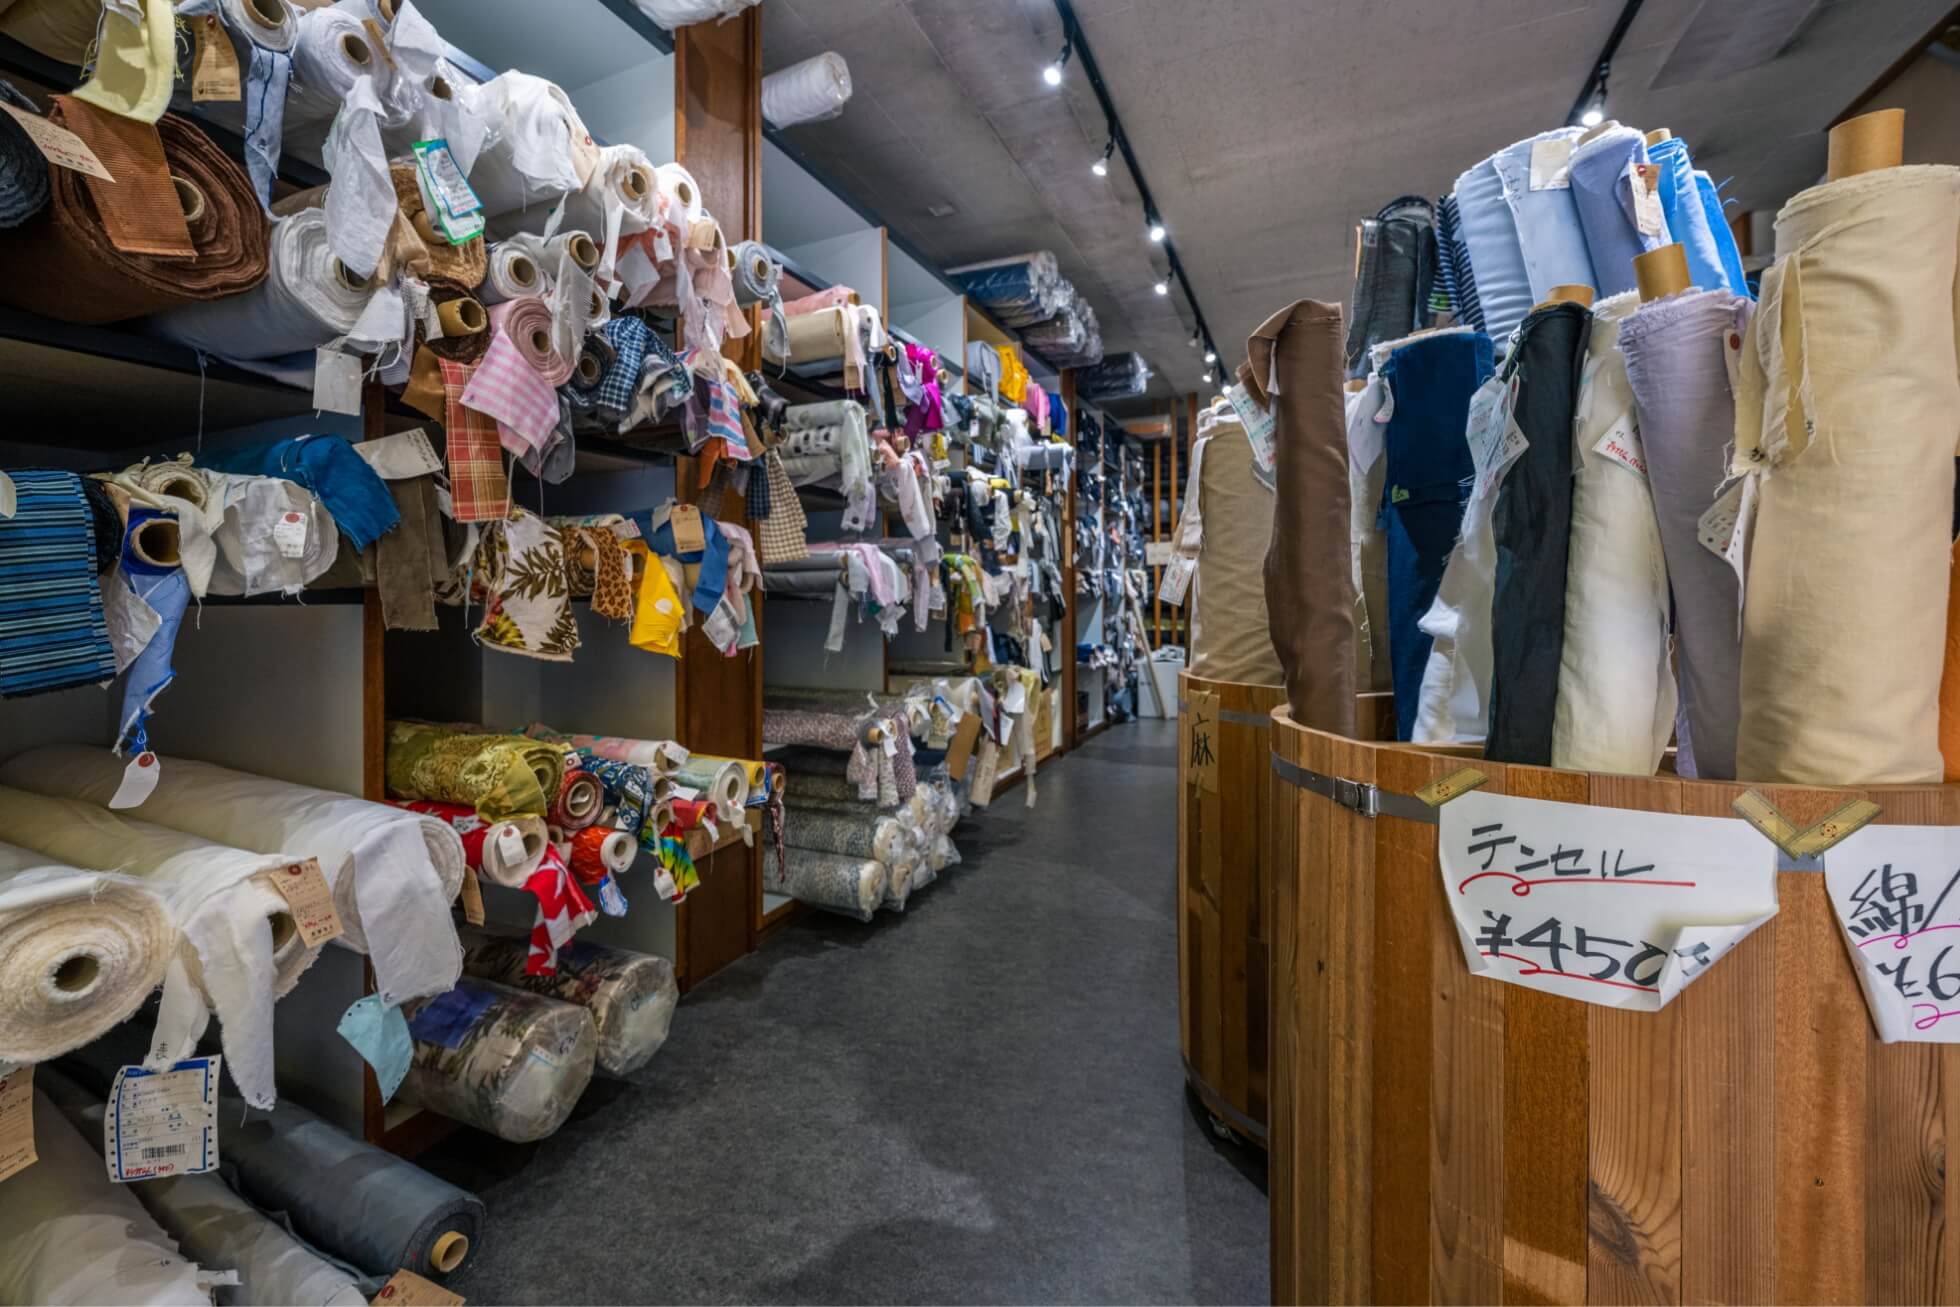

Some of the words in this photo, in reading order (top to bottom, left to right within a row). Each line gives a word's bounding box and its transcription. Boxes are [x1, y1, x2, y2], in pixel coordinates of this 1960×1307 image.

[1190, 711, 1216, 768] 麻
[1468, 822, 1656, 879] テンセル
